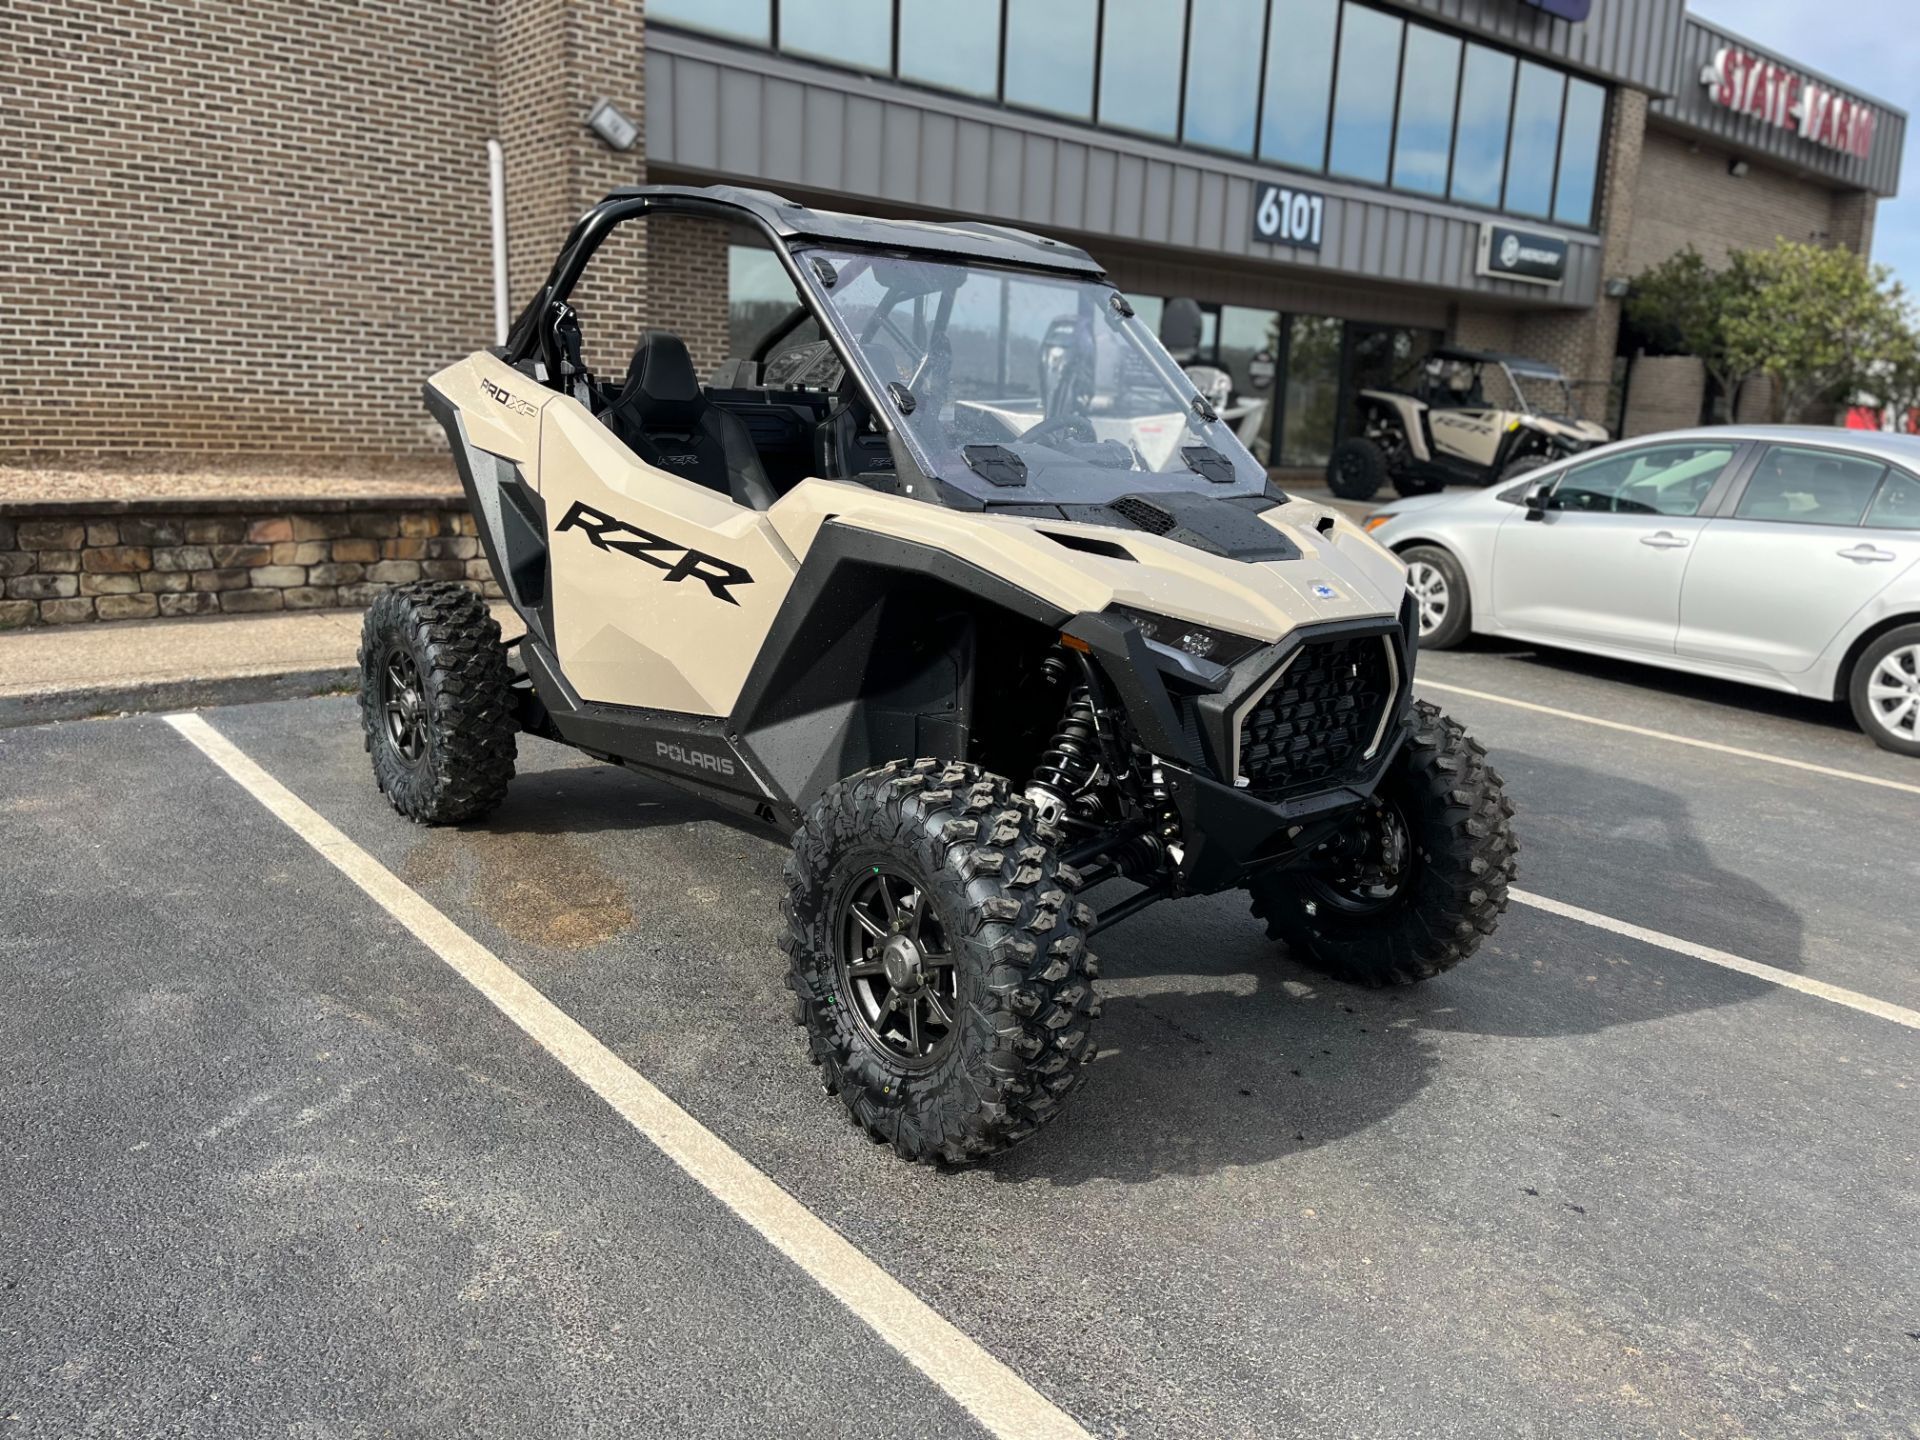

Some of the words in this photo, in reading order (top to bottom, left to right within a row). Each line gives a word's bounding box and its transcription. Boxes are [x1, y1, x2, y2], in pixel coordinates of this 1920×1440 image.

[1709, 47, 1802, 131] STATE
[1256, 186, 1325, 244] 6101
[480, 377, 510, 405] PRO
[505, 394, 539, 417] XP
[554, 500, 756, 608] RZR
[655, 740, 736, 776] POLARIS
